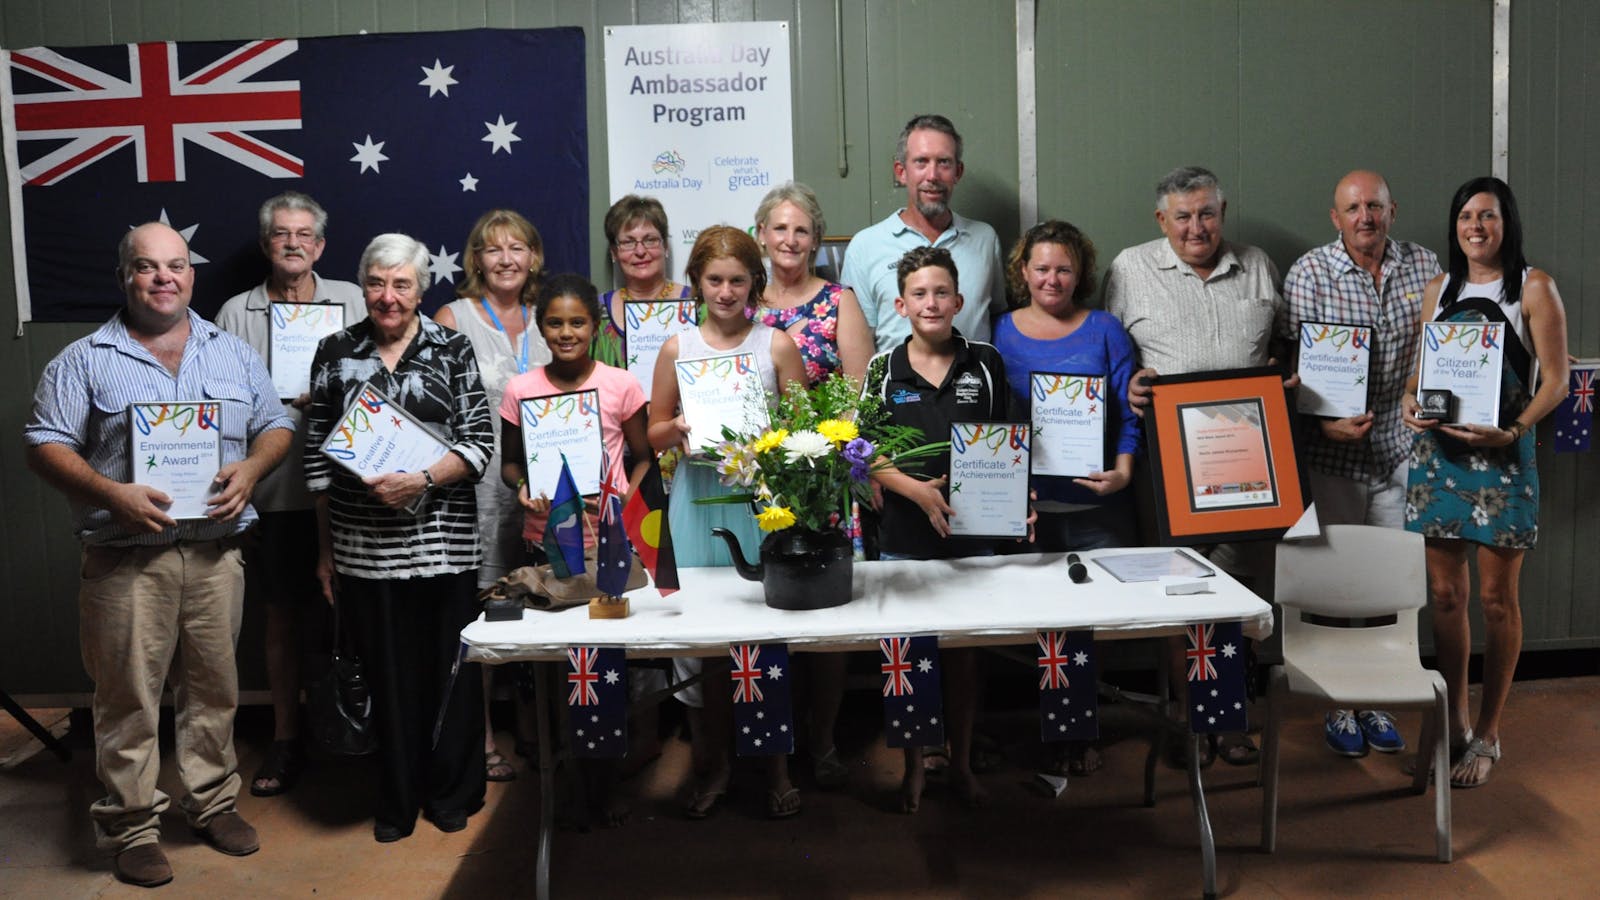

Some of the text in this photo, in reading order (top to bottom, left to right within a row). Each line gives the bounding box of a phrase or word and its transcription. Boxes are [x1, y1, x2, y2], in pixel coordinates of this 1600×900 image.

[624, 45, 771, 67] Australia Day
[630, 72, 767, 95] Ambassador
[653, 104, 745, 127] Program
[714, 156, 759, 166] Celebrate
[634, 177, 703, 191] Australia Day
[728, 172, 769, 191] great!
[630, 333, 670, 343] Certificat
[1302, 352, 1349, 364] Certificate
[1436, 356, 1476, 368] Citizen
[1306, 362, 1364, 374] Appreciation
[1451, 368, 1477, 378] Year
[1035, 406, 1083, 417] Certificate
[1040, 416, 1091, 426] Achievement
[528, 428, 578, 440] Certificate
[140, 441, 216, 452] Environmental
[535, 436, 588, 448] Achievement
[358, 435, 385, 470] Creative
[372, 441, 396, 472] Award
[161, 455, 199, 465] Award
[953, 459, 1007, 470] Certificate
[960, 470, 1015, 479] Achievement
